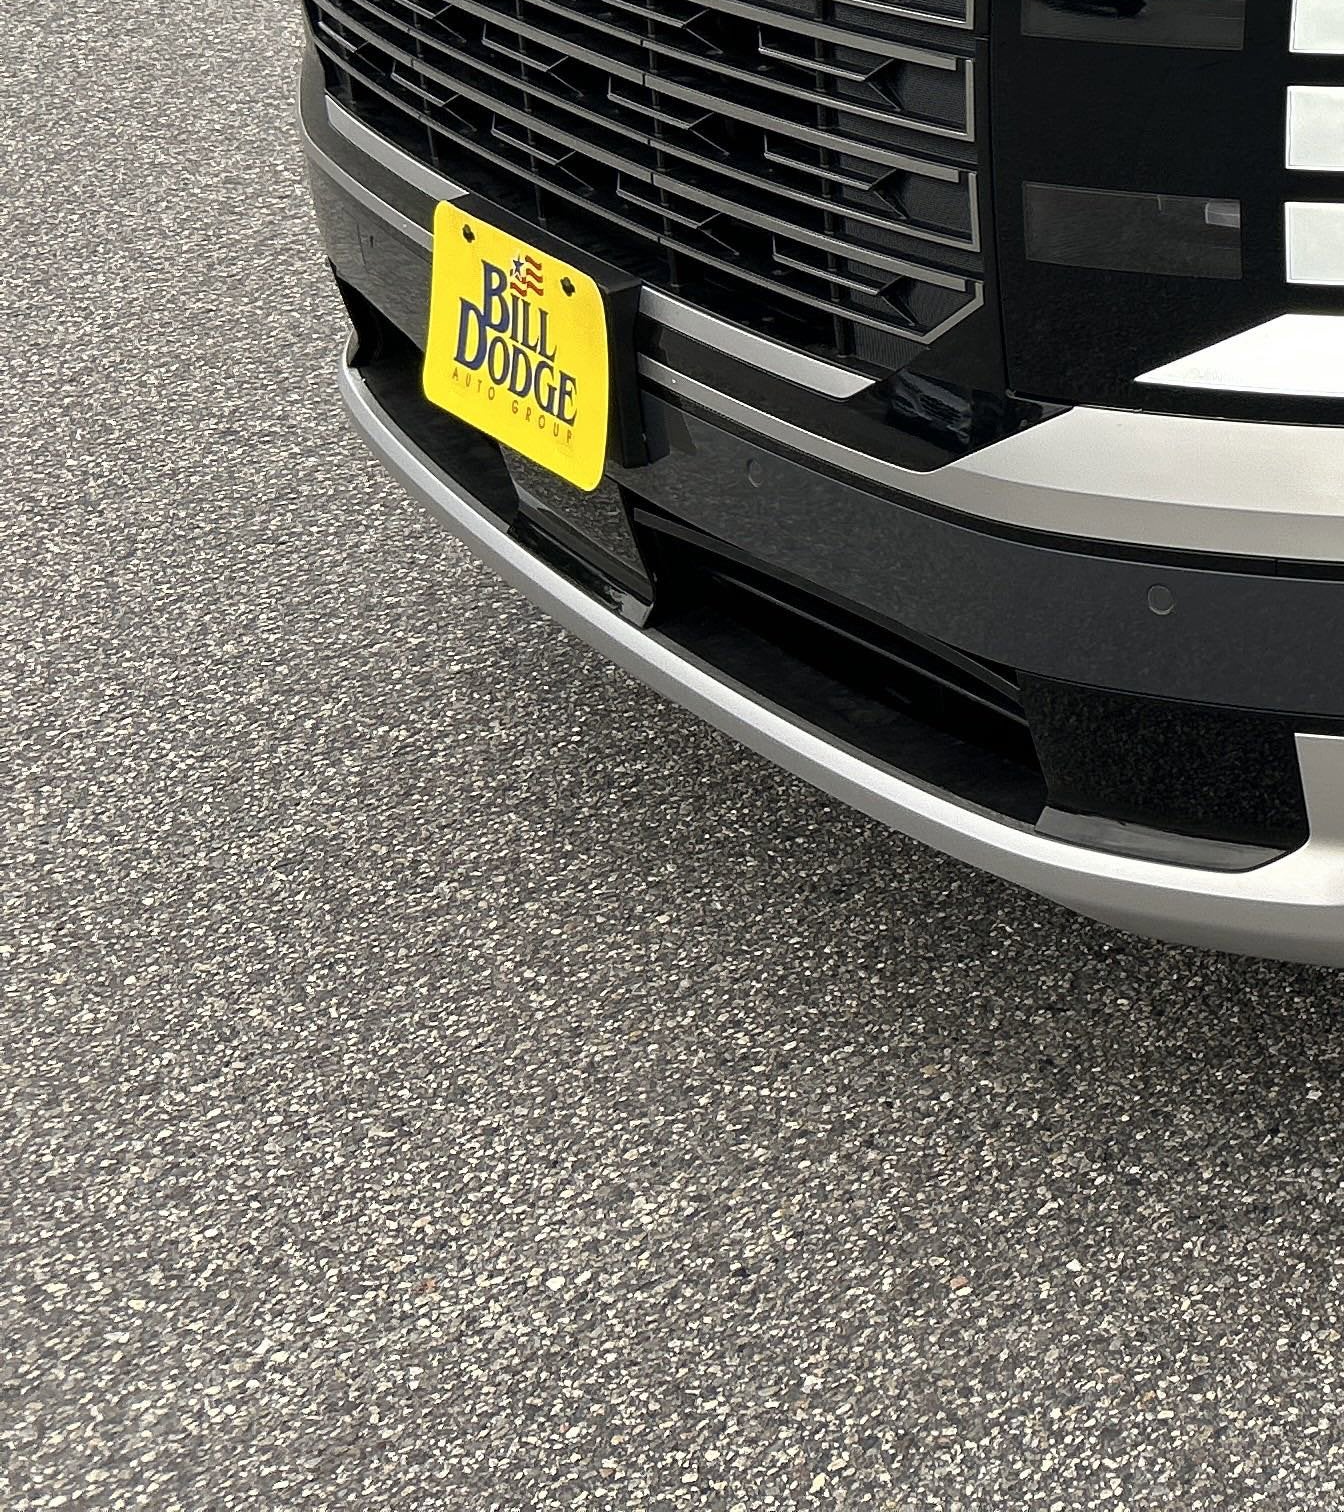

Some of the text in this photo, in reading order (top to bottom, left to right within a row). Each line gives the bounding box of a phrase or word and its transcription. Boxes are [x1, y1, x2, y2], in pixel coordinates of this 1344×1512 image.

[453, 297, 578, 427] DODGE
[481, 260, 558, 363] BILL
[452, 367, 573, 445] AUTO GROUP
